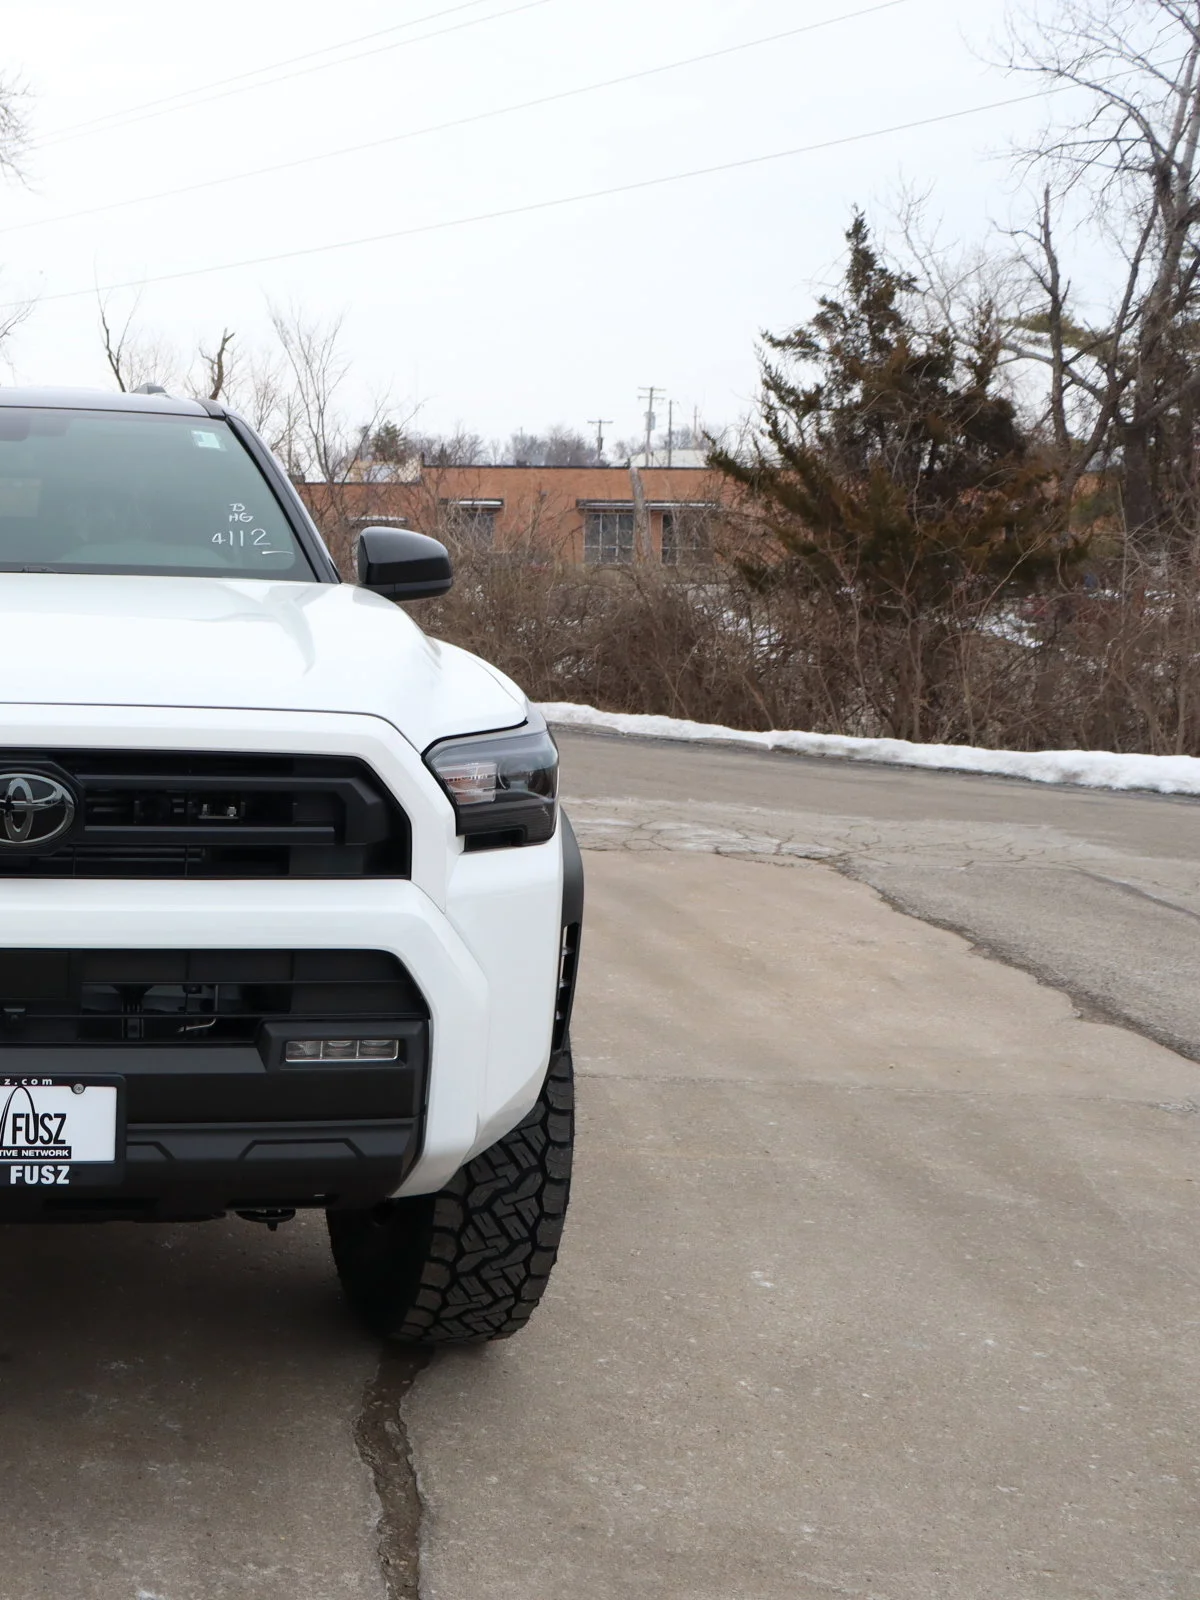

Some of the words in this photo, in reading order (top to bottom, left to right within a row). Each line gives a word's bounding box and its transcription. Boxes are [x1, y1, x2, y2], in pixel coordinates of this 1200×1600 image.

[211, 528, 271, 547] 4112
[12, 1113, 67, 1145] FUSZ
[21, 1149, 69, 1157] NETWORK
[10, 1165, 70, 1184] FUSZ
